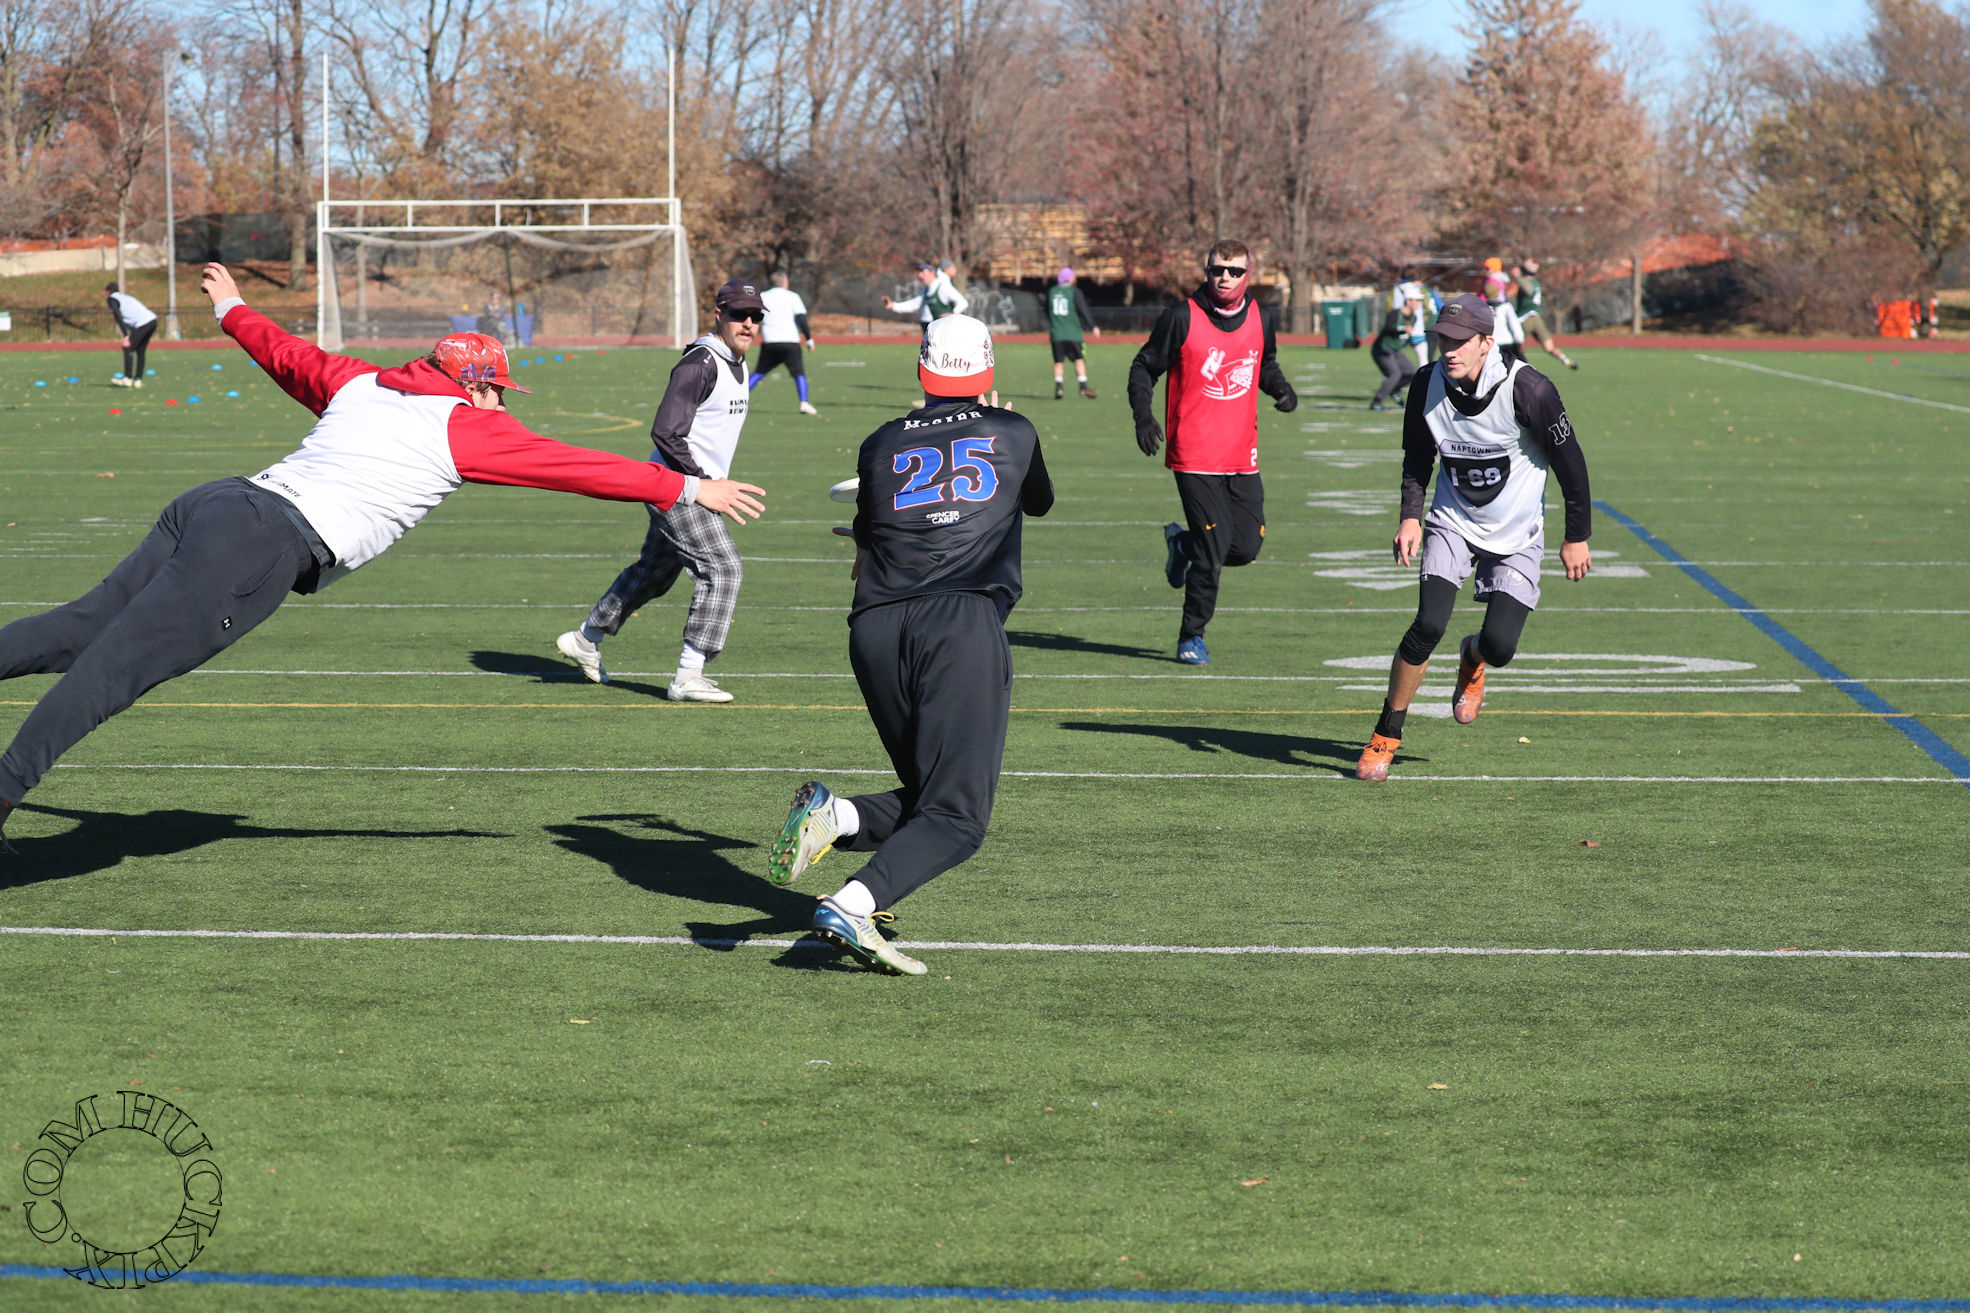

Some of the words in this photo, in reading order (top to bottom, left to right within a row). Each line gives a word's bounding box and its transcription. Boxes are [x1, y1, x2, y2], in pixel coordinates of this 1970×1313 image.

[941, 353, 971, 373] Betty
[1548, 411, 1572, 446] 13
[1450, 443, 1491, 454] NAPTOWN
[892, 436, 999, 511] 25
[1450, 466, 1502, 488] I-69
